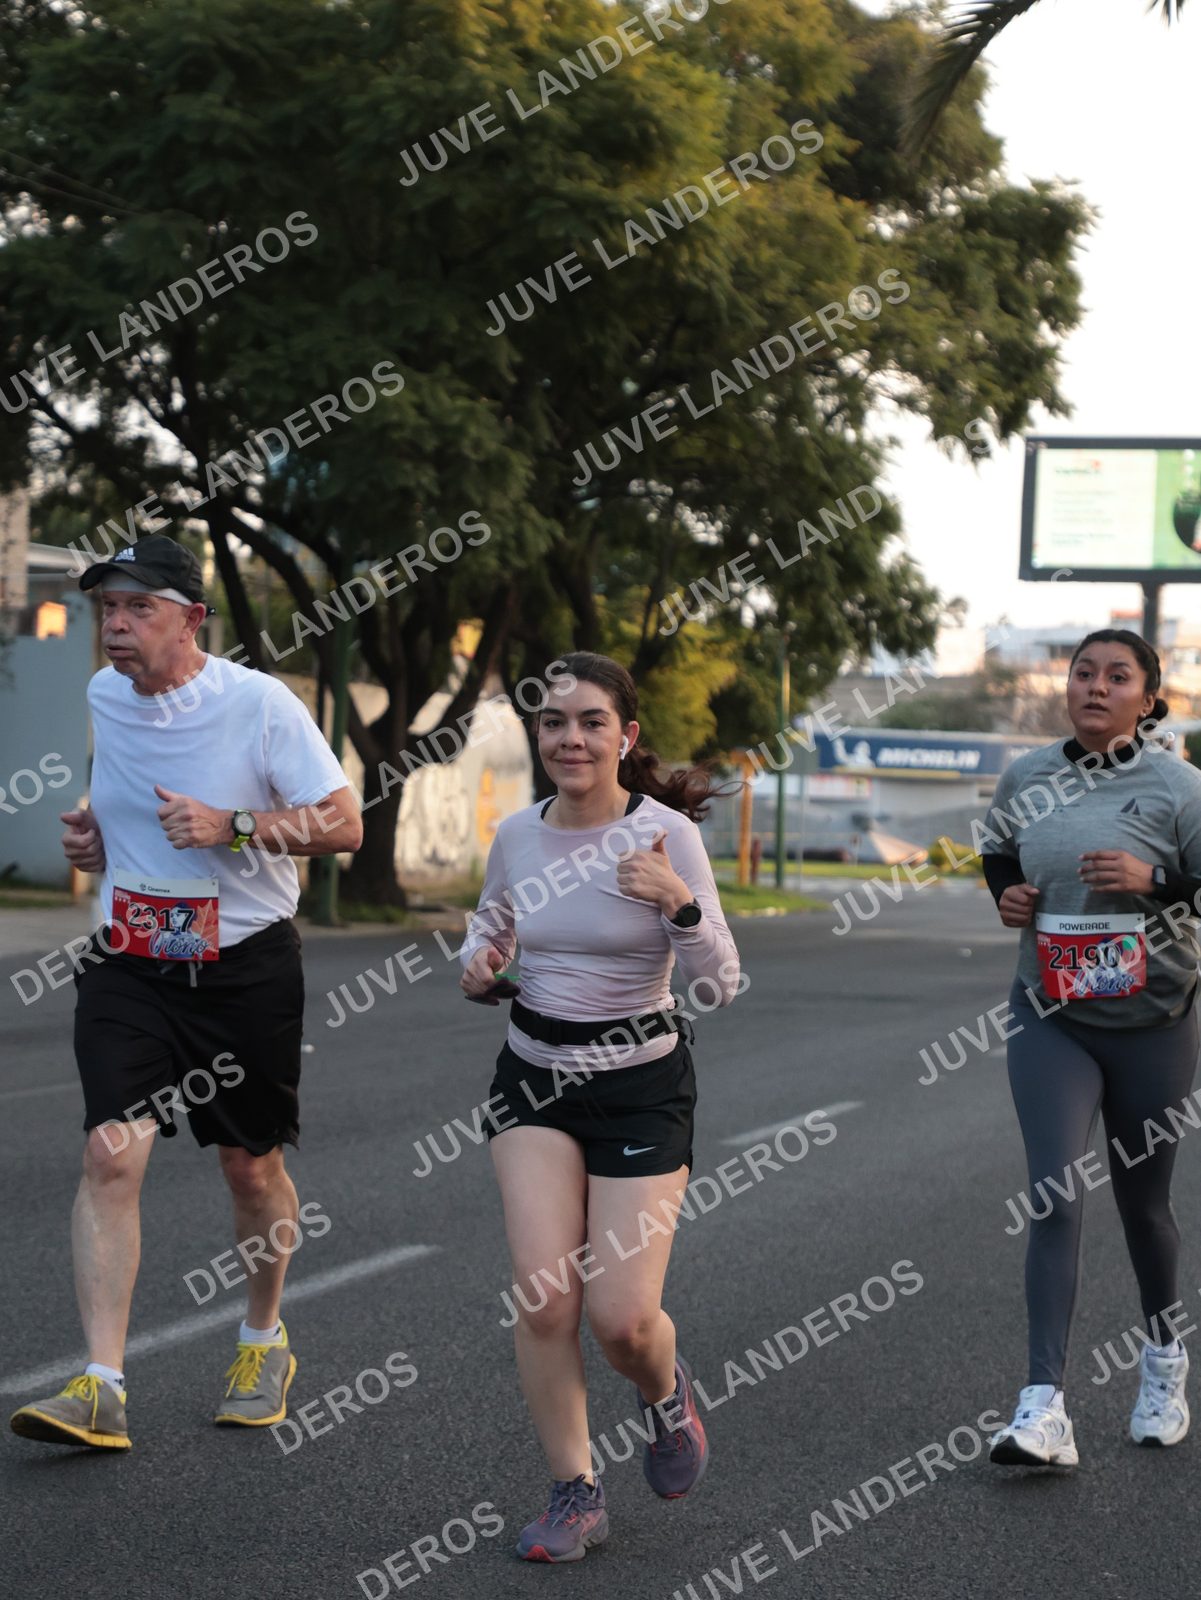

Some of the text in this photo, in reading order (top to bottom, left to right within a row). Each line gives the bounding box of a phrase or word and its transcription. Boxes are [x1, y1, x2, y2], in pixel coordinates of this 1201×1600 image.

[877, 747, 981, 769] MICHELIN
[128, 902, 194, 933] 2317
[1059, 921, 1111, 931] POWERADE
[1049, 944, 1121, 971] 2190
